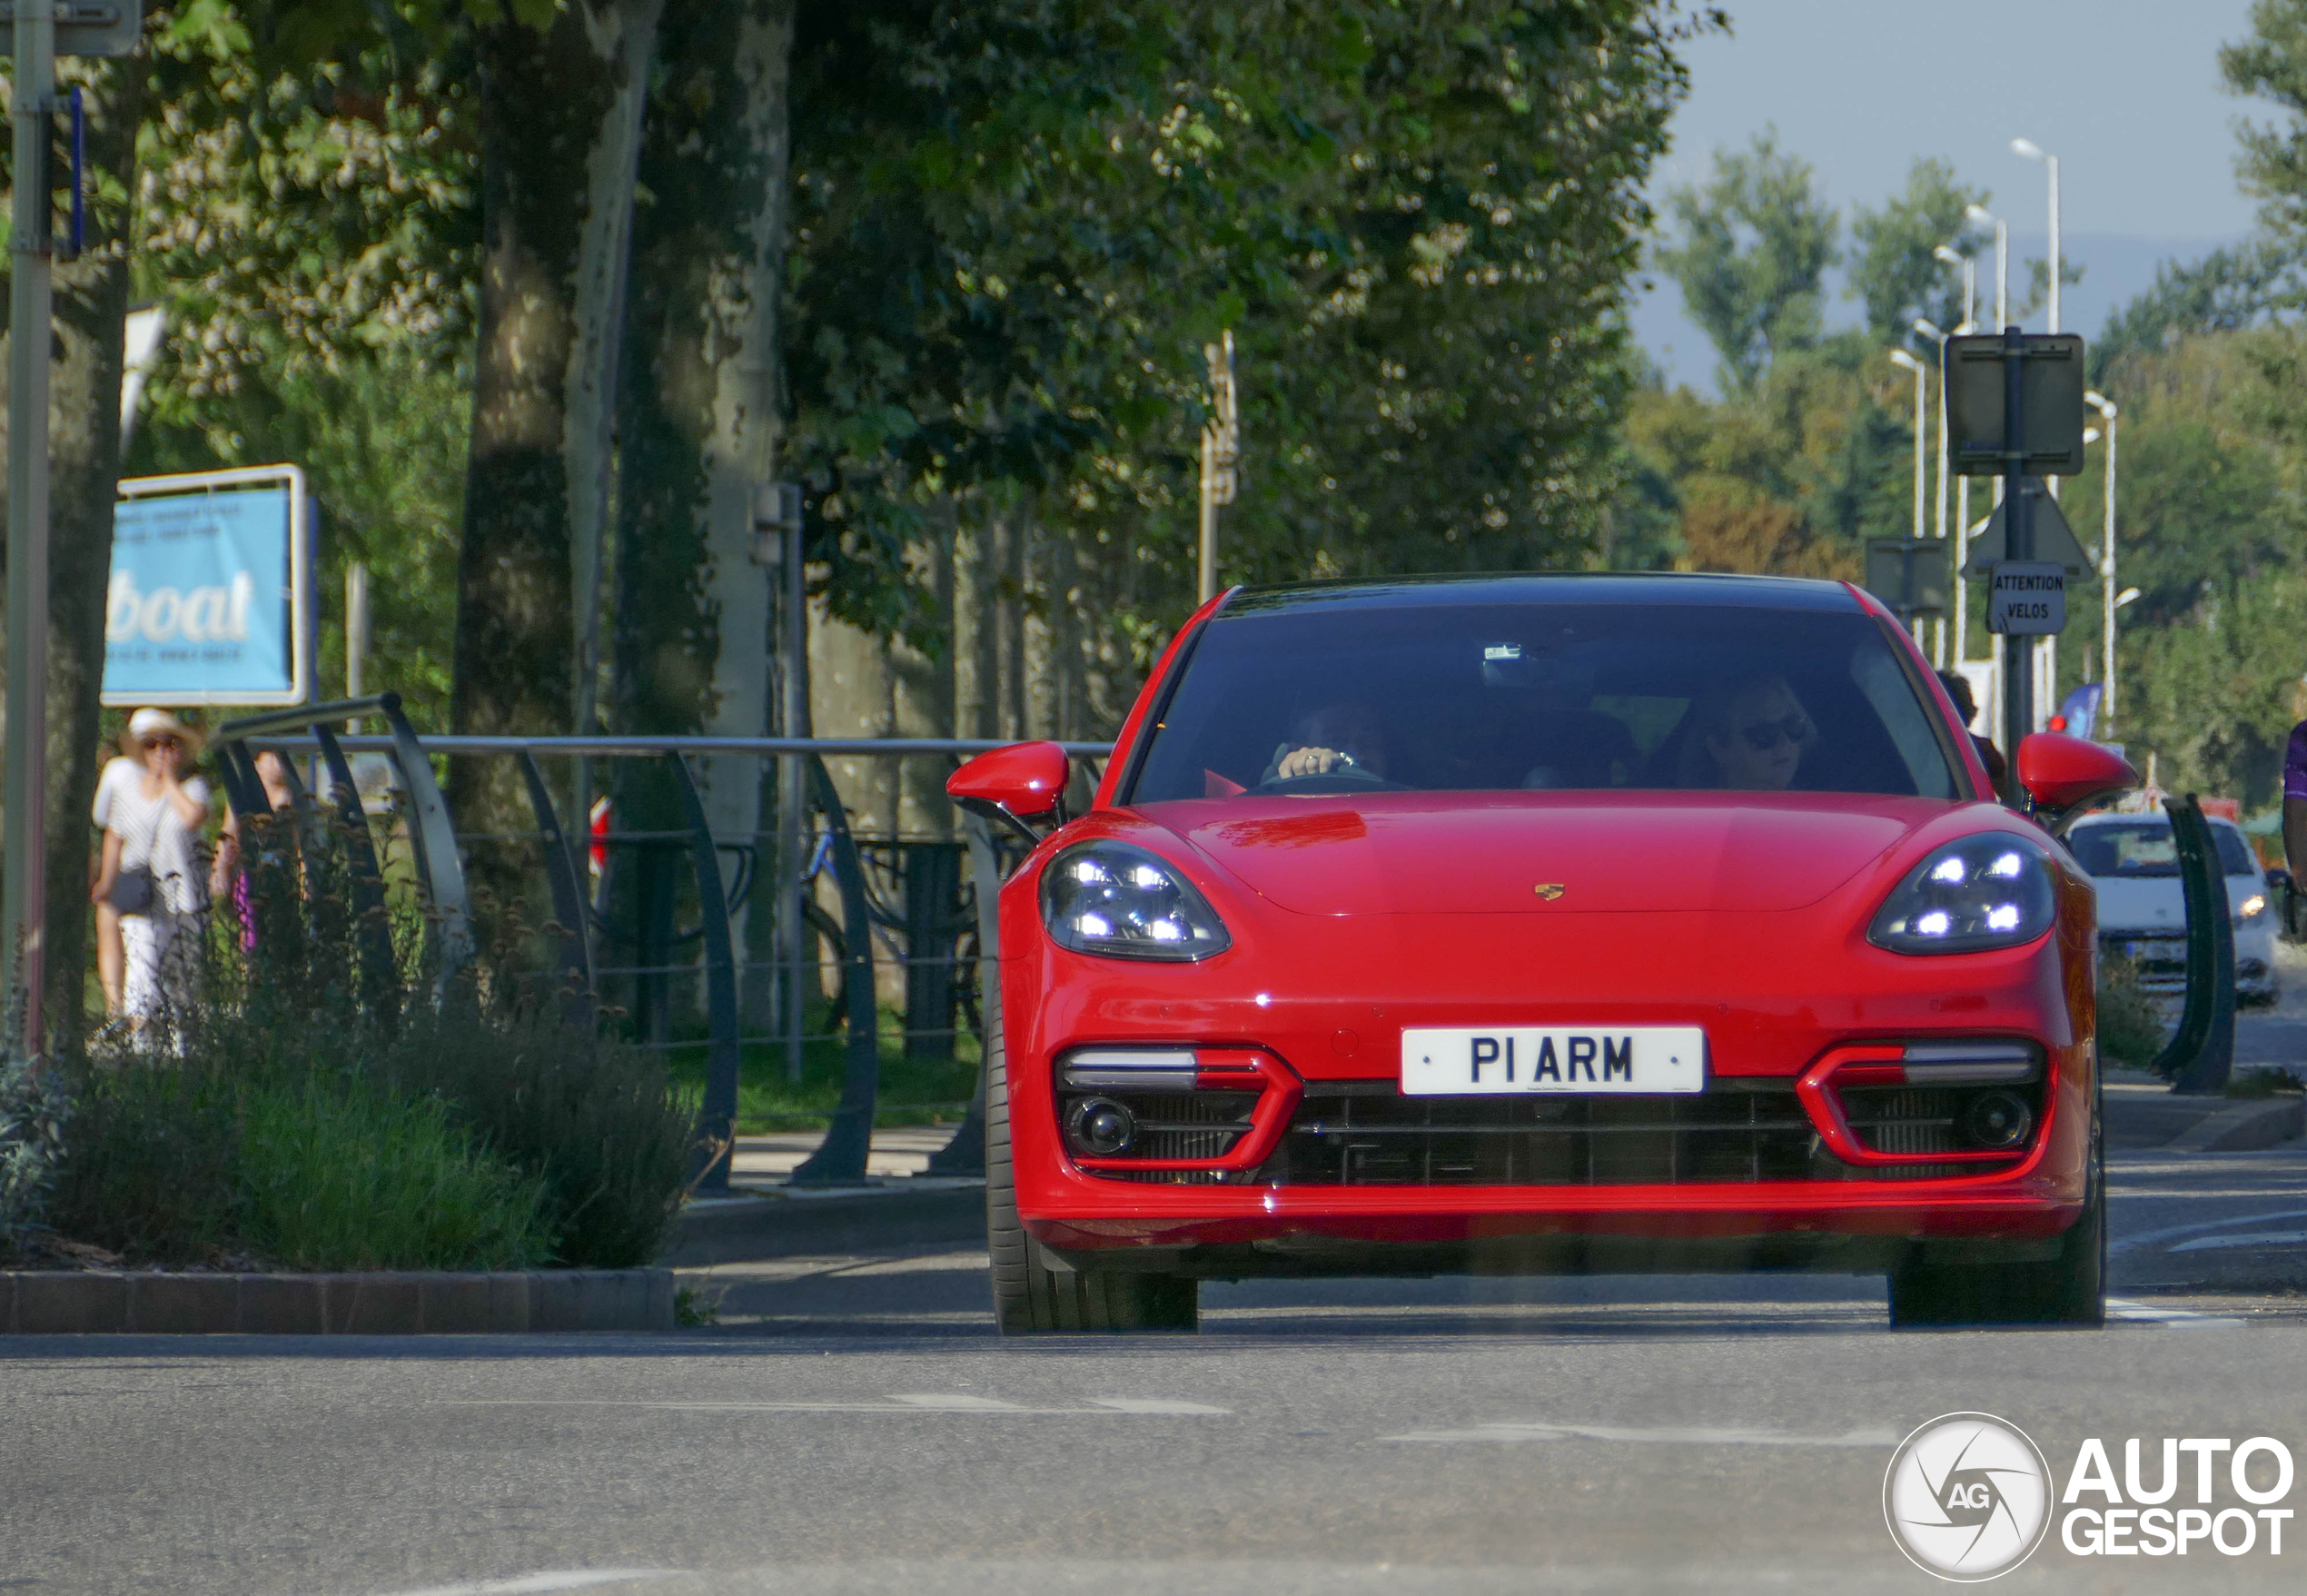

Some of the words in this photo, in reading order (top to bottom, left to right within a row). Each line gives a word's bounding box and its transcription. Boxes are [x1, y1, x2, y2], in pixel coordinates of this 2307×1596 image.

[1994, 575, 2064, 590] ATTENTION
[2007, 602, 2049, 619] VELOS
[1533, 1036, 1633, 1083] ARM
